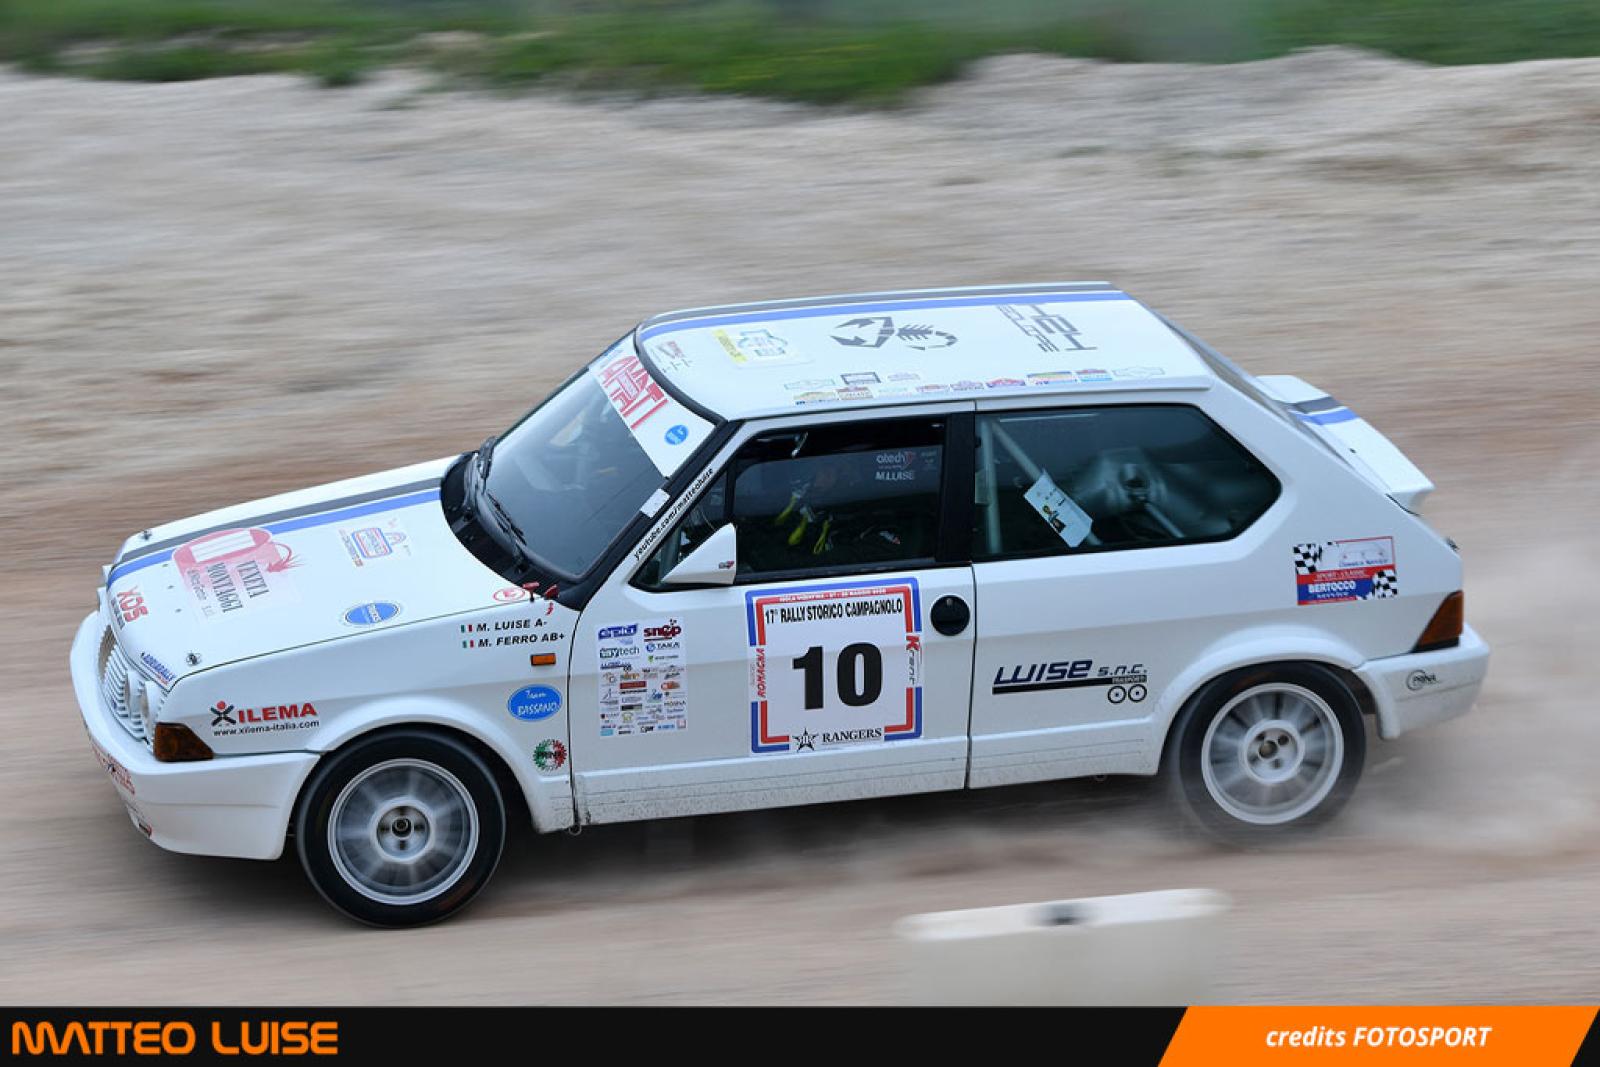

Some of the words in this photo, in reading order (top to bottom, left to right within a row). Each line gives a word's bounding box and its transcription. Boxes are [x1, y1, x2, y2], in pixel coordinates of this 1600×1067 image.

[1307, 581, 1357, 593] BERTOCCO
[781, 606, 805, 623] RALLY
[807, 602, 843, 620] STORICO
[845, 598, 903, 617] CAMPAGNOLO
[477, 623, 490, 632] M.
[495, 619, 531, 630] LUISE
[534, 618, 547, 627] A-
[478, 639, 492, 648] M.
[496, 634, 538, 646] FERRO
[541, 632, 565, 643] AB+
[793, 642, 882, 709] 10
[1098, 664, 1148, 677] s.n.c.
[518, 703, 557, 716] BASSANO
[213, 720, 320, 736] www.xilema-italia.com
[823, 728, 882, 743] RANGERS
